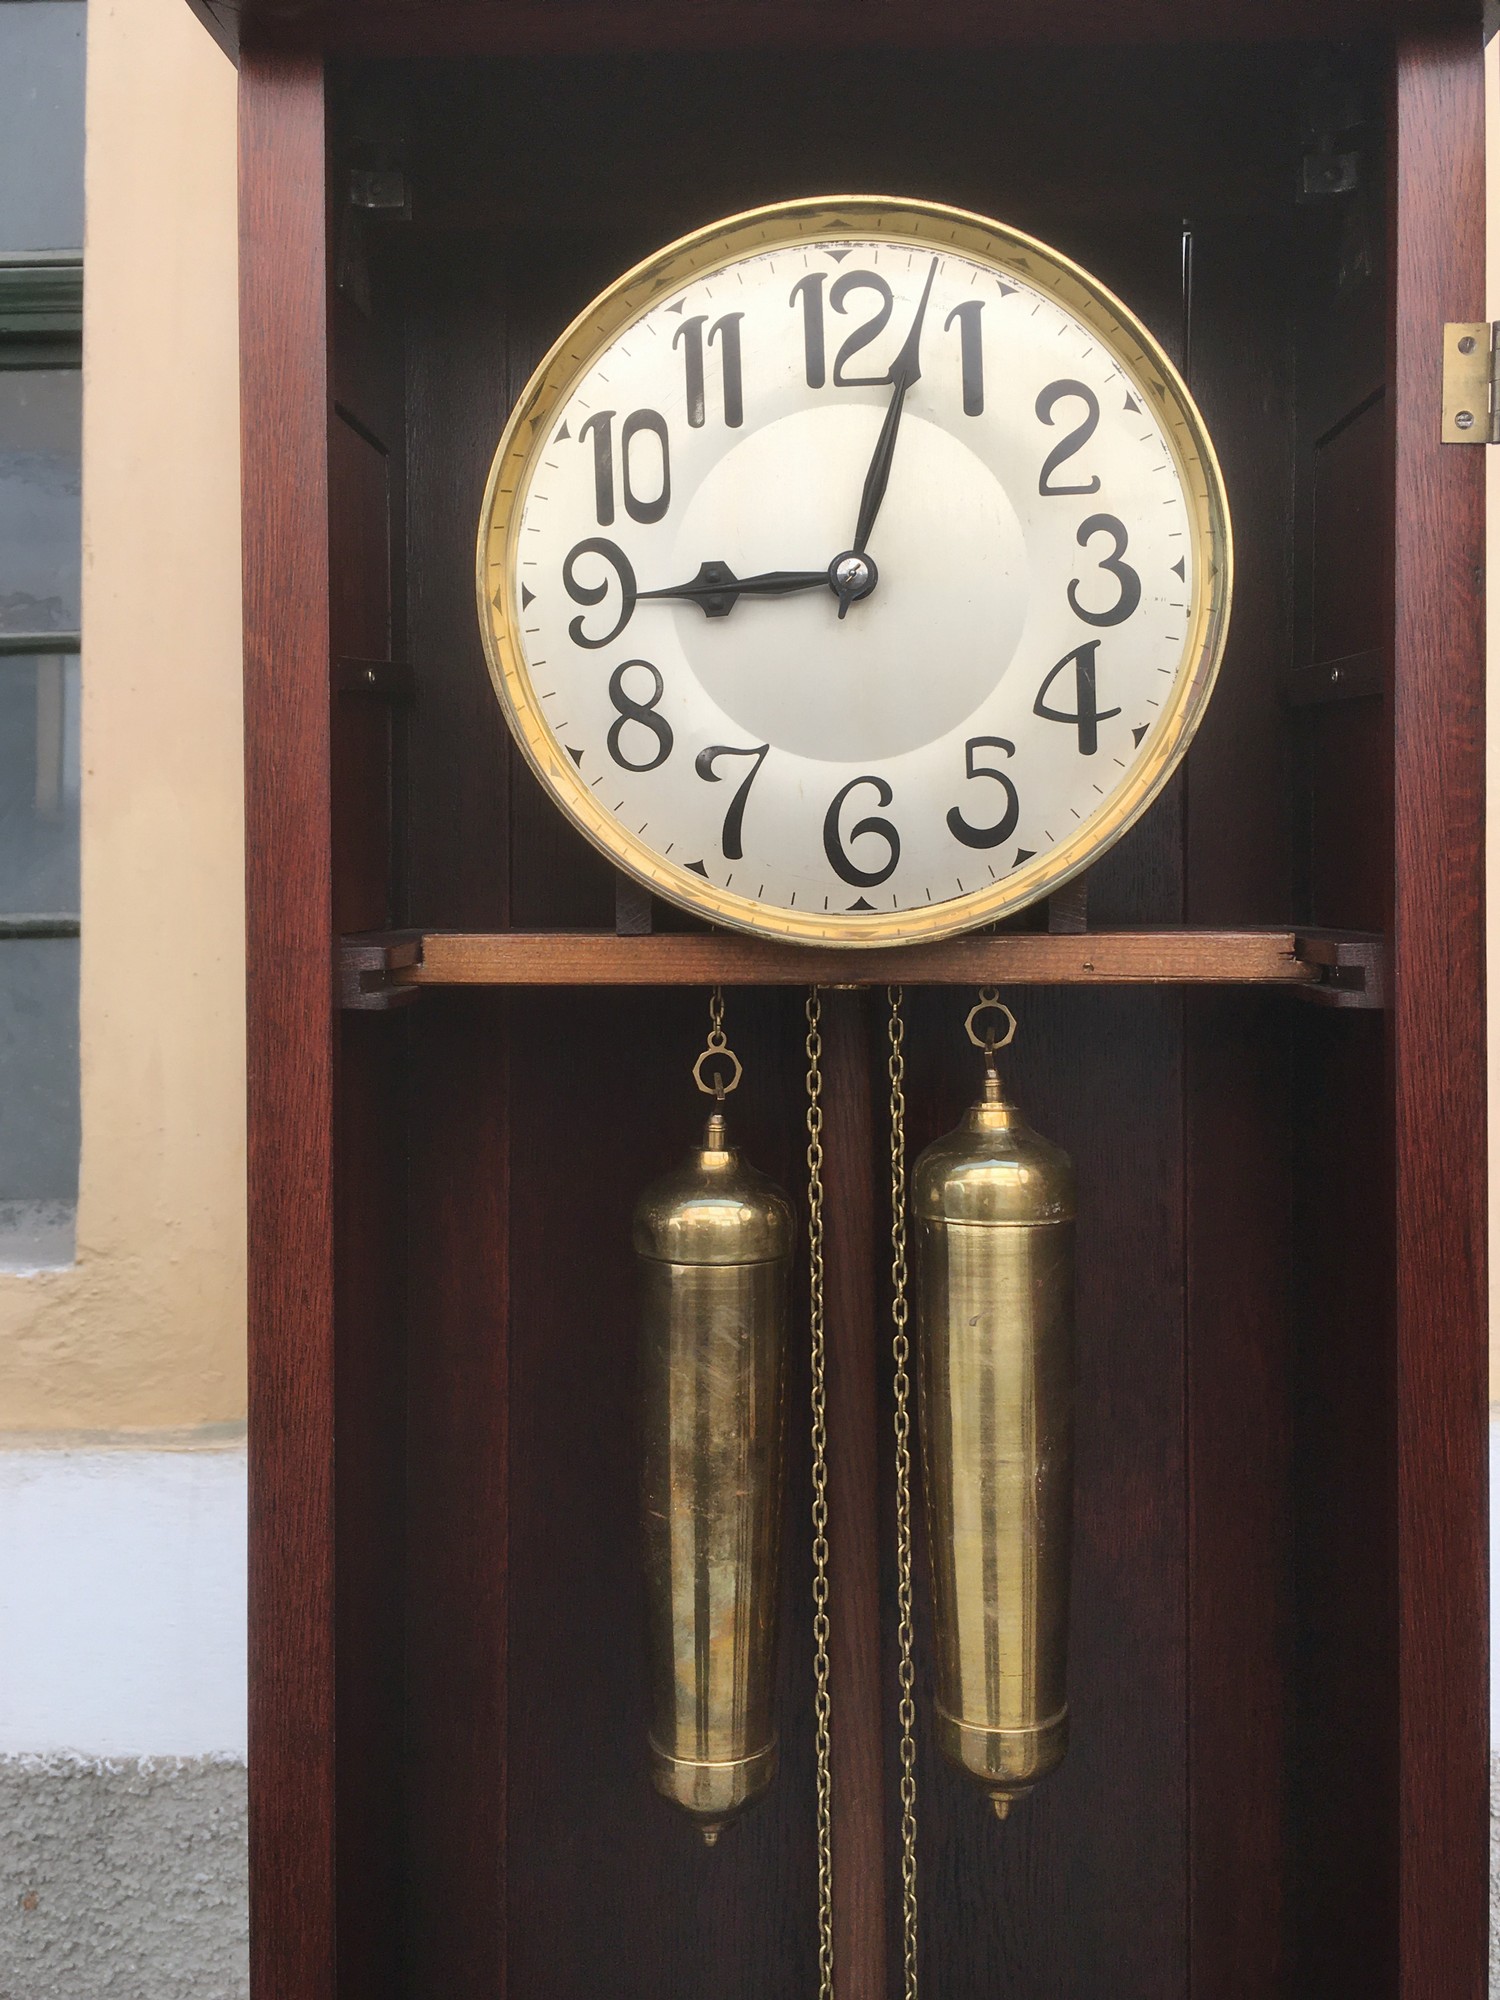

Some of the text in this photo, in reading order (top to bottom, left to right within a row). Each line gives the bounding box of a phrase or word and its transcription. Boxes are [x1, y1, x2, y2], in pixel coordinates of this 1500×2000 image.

[672, 312, 745, 428] 11
[789, 269, 896, 389] 12
[944, 300, 985, 417] 1
[578, 408, 671, 526] 10
[1034, 379, 1101, 497] 2
[562, 537, 637, 650] 9
[1067, 513, 1142, 627] 3
[607, 659, 674, 773] 8
[1033, 639, 1122, 756] 4
[695, 743, 770, 860] 7
[823, 775, 901, 888] 6
[946, 736, 1020, 850] 5
